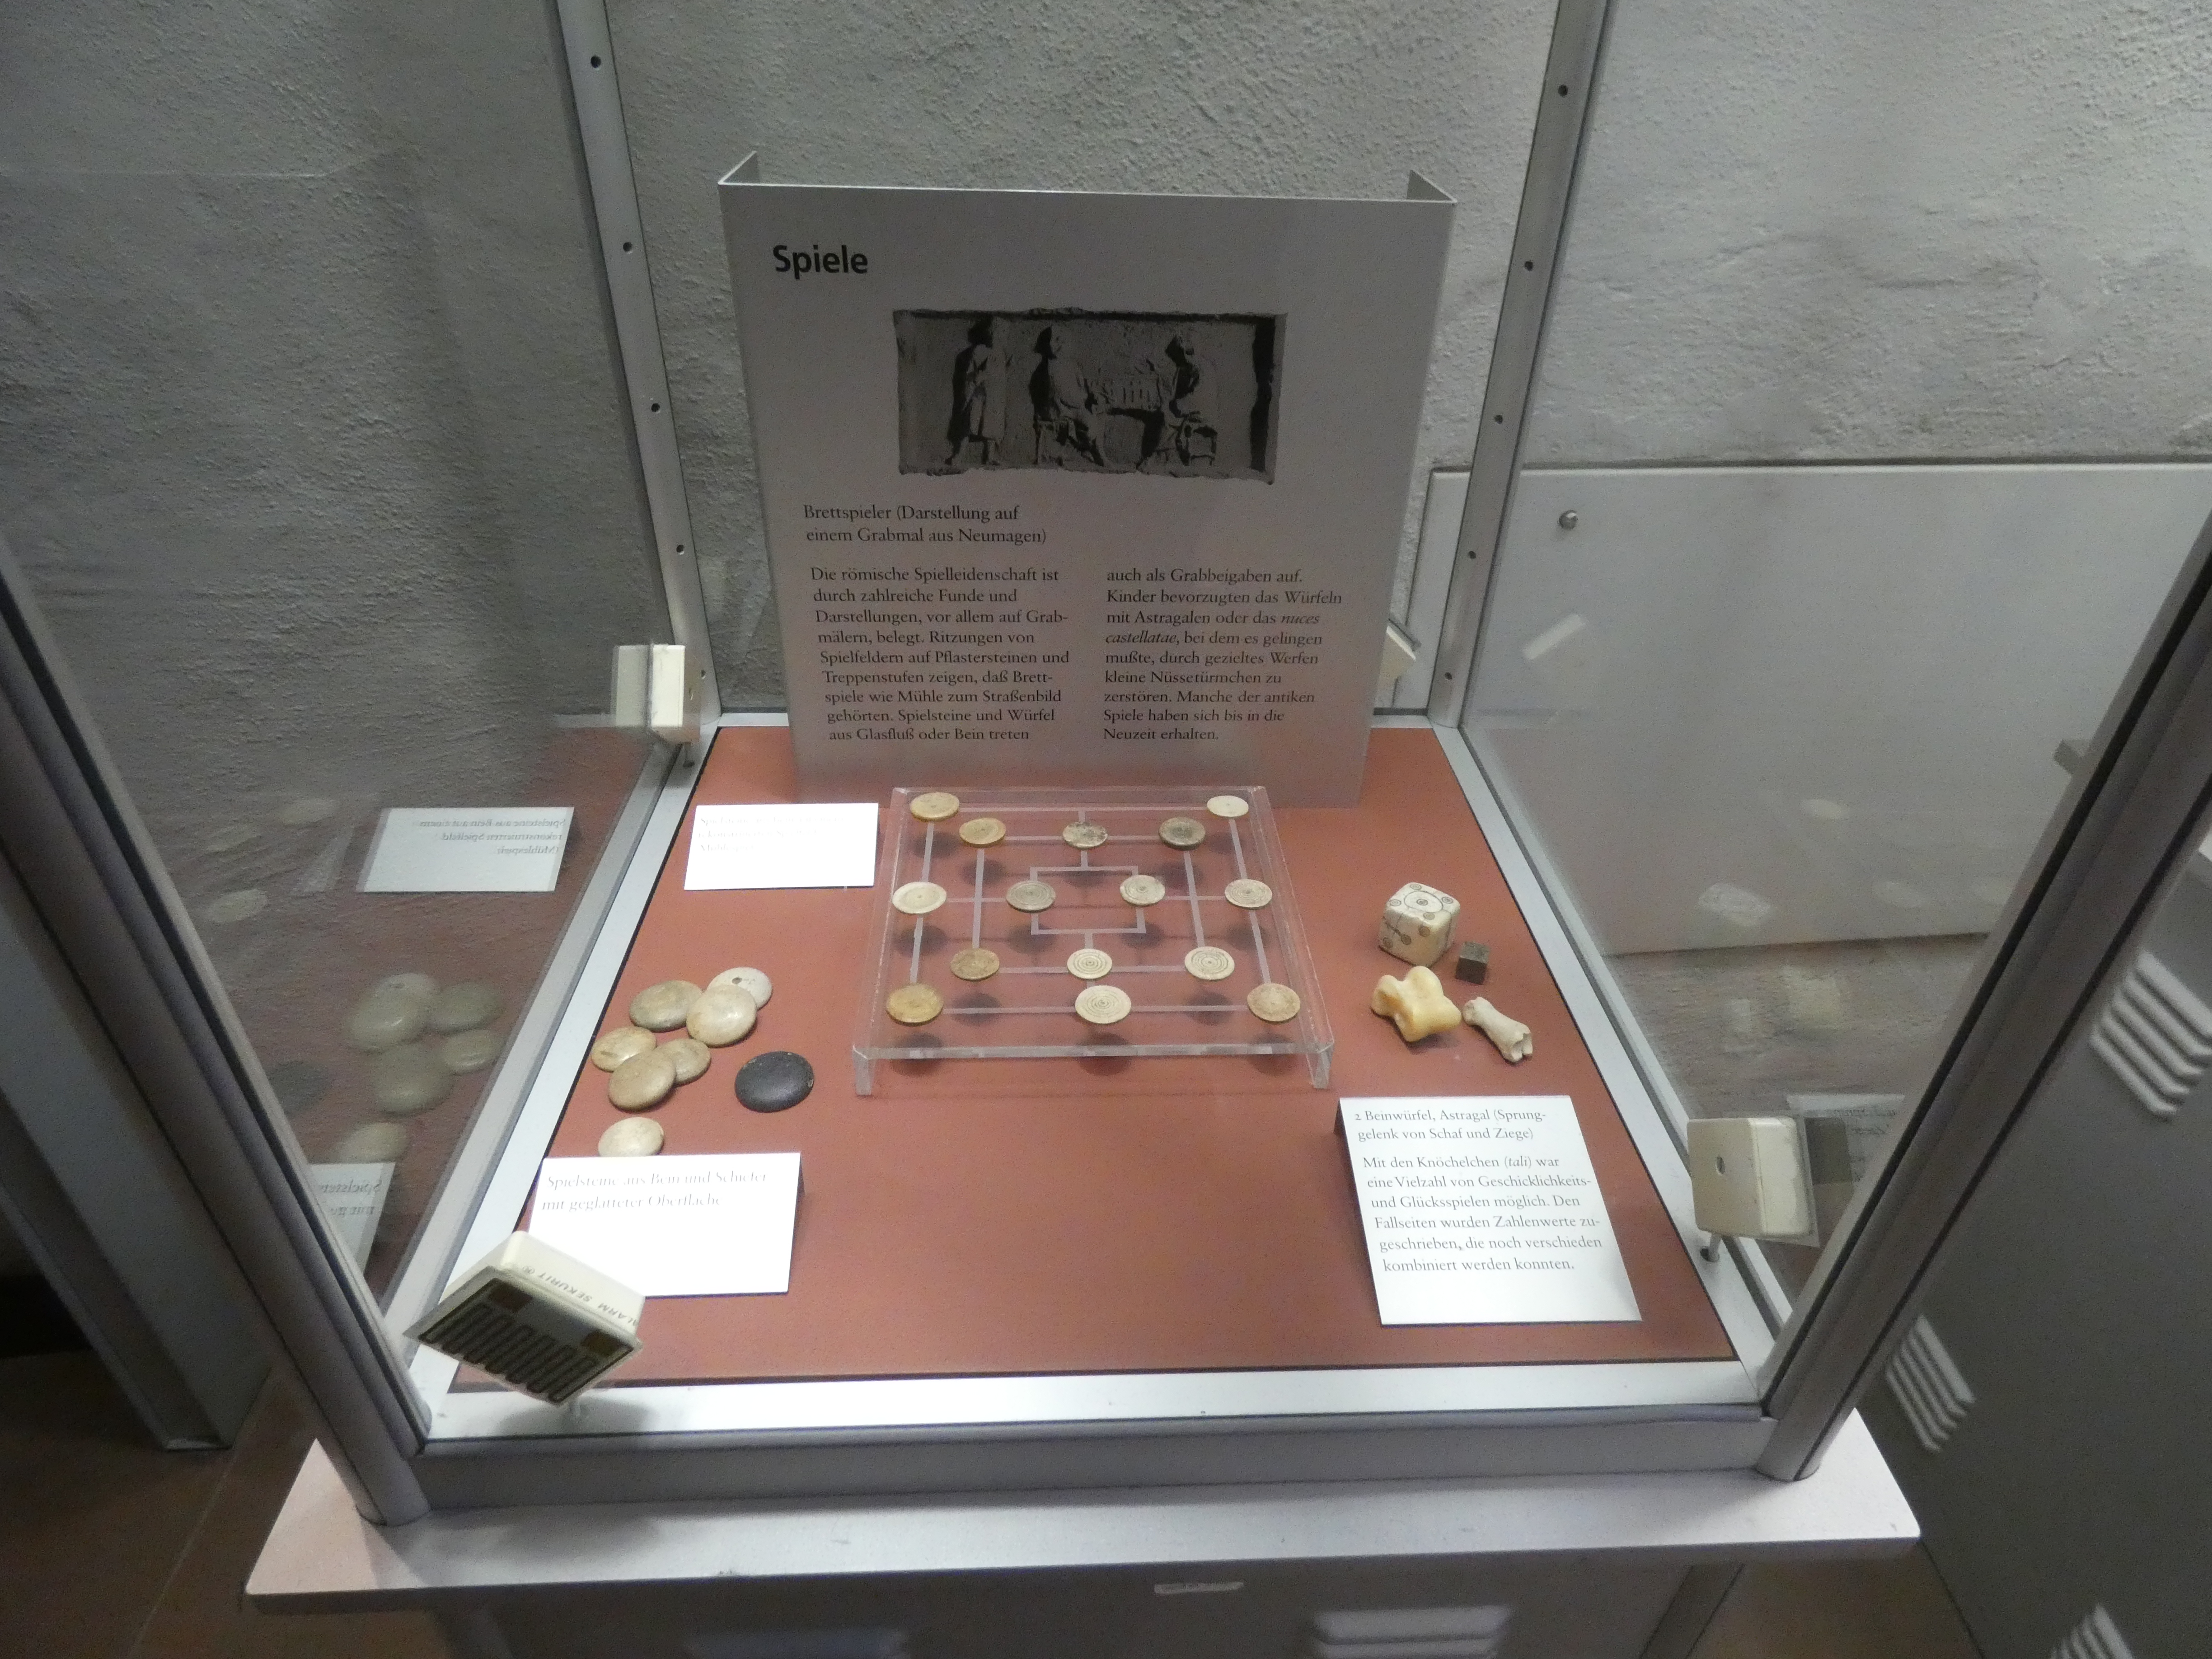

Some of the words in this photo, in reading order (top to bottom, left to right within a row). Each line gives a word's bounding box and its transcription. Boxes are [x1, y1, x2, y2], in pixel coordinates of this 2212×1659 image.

[773, 244, 868, 280] Spiele
[804, 504, 892, 521] Brettspieler
[897, 505, 990, 522] (Darstellung
[995, 506, 1019, 520] auf
[806, 530, 852, 541] einem
[858, 528, 923, 541] Grabmal
[929, 531, 953, 541] aus
[959, 528, 1046, 546] Neumagen)
[811, 567, 836, 581] Die
[842, 567, 909, 581] römische
[914, 567, 1037, 583] Spielleidenschaft
[1042, 569, 1059, 581] ist
[1107, 568, 1141, 581] auch
[1146, 568, 1165, 581] als
[1170, 568, 1271, 584] Grabbeigaben
[1276, 569, 1302, 582] auf.
[814, 589, 855, 602] durch
[861, 589, 933, 602] zahlreiche
[939, 589, 984, 601] Funde
[989, 589, 1017, 601] und
[1106, 590, 1156, 603] Kinder
[1161, 590, 1250, 606] bevorzugten
[1255, 590, 1279, 603] das
[1285, 590, 1342, 603] Würfeln
[816, 610, 921, 625] Darstellungen,
[927, 613, 951, 623] vor
[956, 610, 994, 623] allem
[999, 610, 1022, 623] auf
[1026, 610, 1068, 623] Grab-
[1107, 611, 1130, 623] mit
[1135, 610, 1210, 626] Astragalen
[1216, 611, 1248, 623] oder
[1253, 611, 1275, 623] das
[1281, 614, 1320, 623] nuces
[818, 631, 872, 644] mälern,
[877, 631, 924, 646] belegt.
[930, 631, 1002, 646] Ritzungen
[1008, 634, 1034, 643] von
[1106, 631, 1178, 645] castellatae,
[1185, 631, 1204, 643] bei
[1209, 632, 1239, 644] dem
[1244, 635, 1258, 644] es
[1263, 632, 1322, 647] gelingen
[820, 651, 903, 666] Spielfeldern
[909, 651, 930, 663] auf
[936, 651, 1036, 663] Pflastersteinen
[1043, 651, 1069, 663] und
[1106, 651, 1155, 665] mußte,
[1160, 651, 1200, 663] durch
[1205, 651, 1263, 666] gezieltes
[1270, 652, 1318, 664] Werfen
[822, 670, 923, 686] Treppenstufen
[929, 672, 978, 686] zeigen,
[983, 671, 1008, 683] daß
[1013, 671, 1052, 683] Brett-
[1105, 670, 1145, 683] kleine
[1151, 670, 1261, 683] Nüssetürmchen
[1266, 674, 1281, 683] zu
[825, 690, 864, 705] spiele
[869, 691, 893, 702] wie
[897, 690, 942, 702] Mühle
[948, 693, 978, 702] zum
[983, 690, 1061, 702] Straßenbild
[1104, 691, 1172, 702] zerstören.
[1176, 690, 1233, 702] Manche
[1238, 690, 1260, 702] der
[1265, 691, 1314, 703] antiken
[828, 710, 893, 724] gehörten.
[898, 710, 971, 724] Spielsteine
[976, 710, 1002, 721] und
[1008, 710, 1055, 721] Würfel
[1104, 709, 1143, 723] Spiele
[1148, 709, 1188, 721] haben
[1194, 709, 1218, 721] sich
[1225, 709, 1242, 721] bis
[1248, 710, 1259, 721] in
[1265, 709, 1284, 721] die
[830, 731, 852, 740] aus
[857, 728, 914, 740] Glasfluß
[919, 728, 950, 740] oder
[955, 728, 984, 740] Bein
[989, 730, 1029, 740] treten
[1104, 728, 1155, 740] Neuzeit
[1161, 727, 1218, 740] erhalten.
[1355, 1112, 1362, 1120] 2
[1365, 1109, 1436, 1123] Beinwürfel,
[1439, 1109, 1490, 1124] Astragal
[1494, 1109, 1546, 1124] (Sprung-
[1358, 1128, 1399, 1142] gelenk
[1430, 1127, 1463, 1139] Schaf
[1467, 1128, 1490, 1139] und
[1495, 1127, 1533, 1142] Ziege)
[1364, 1157, 1387, 1167] Mit
[1391, 1157, 1412, 1167] den
[1417, 1156, 1499, 1168] Knöchelchen
[1504, 1156, 1532, 1169] (tali)
[685, 1172, 711, 1184] und
[1367, 1178, 1392, 1188] eine
[1395, 1175, 1446, 1188] Vielzahl
[1450, 1178, 1475, 1187] von
[1478, 1175, 1591, 1186] Geschicklichkeits-
[542, 1199, 565, 1210] mit
[1372, 1197, 1396, 1208] und
[1401, 1195, 1490, 1211] Glücksspielen
[1495, 1195, 1550, 1210] möglich.
[1554, 1195, 1580, 1206] Den
[1376, 1216, 1436, 1228] Fallseiten
[1441, 1216, 1490, 1228] wurden
[1494, 1215, 1576, 1228] Zahlenwerte
[1580, 1218, 1600, 1227] zu-
[1380, 1237, 1462, 1252] geschrieben,
[1466, 1237, 1485, 1249] die
[1489, 1236, 1522, 1249] noch
[1525, 1236, 1602, 1248] verschieden
[1383, 1259, 1457, 1271] kombiniert
[1462, 1258, 1511, 1270] werden
[1514, 1258, 1574, 1270] konnten.
[537, 1272, 592, 1303] SEKURIT
